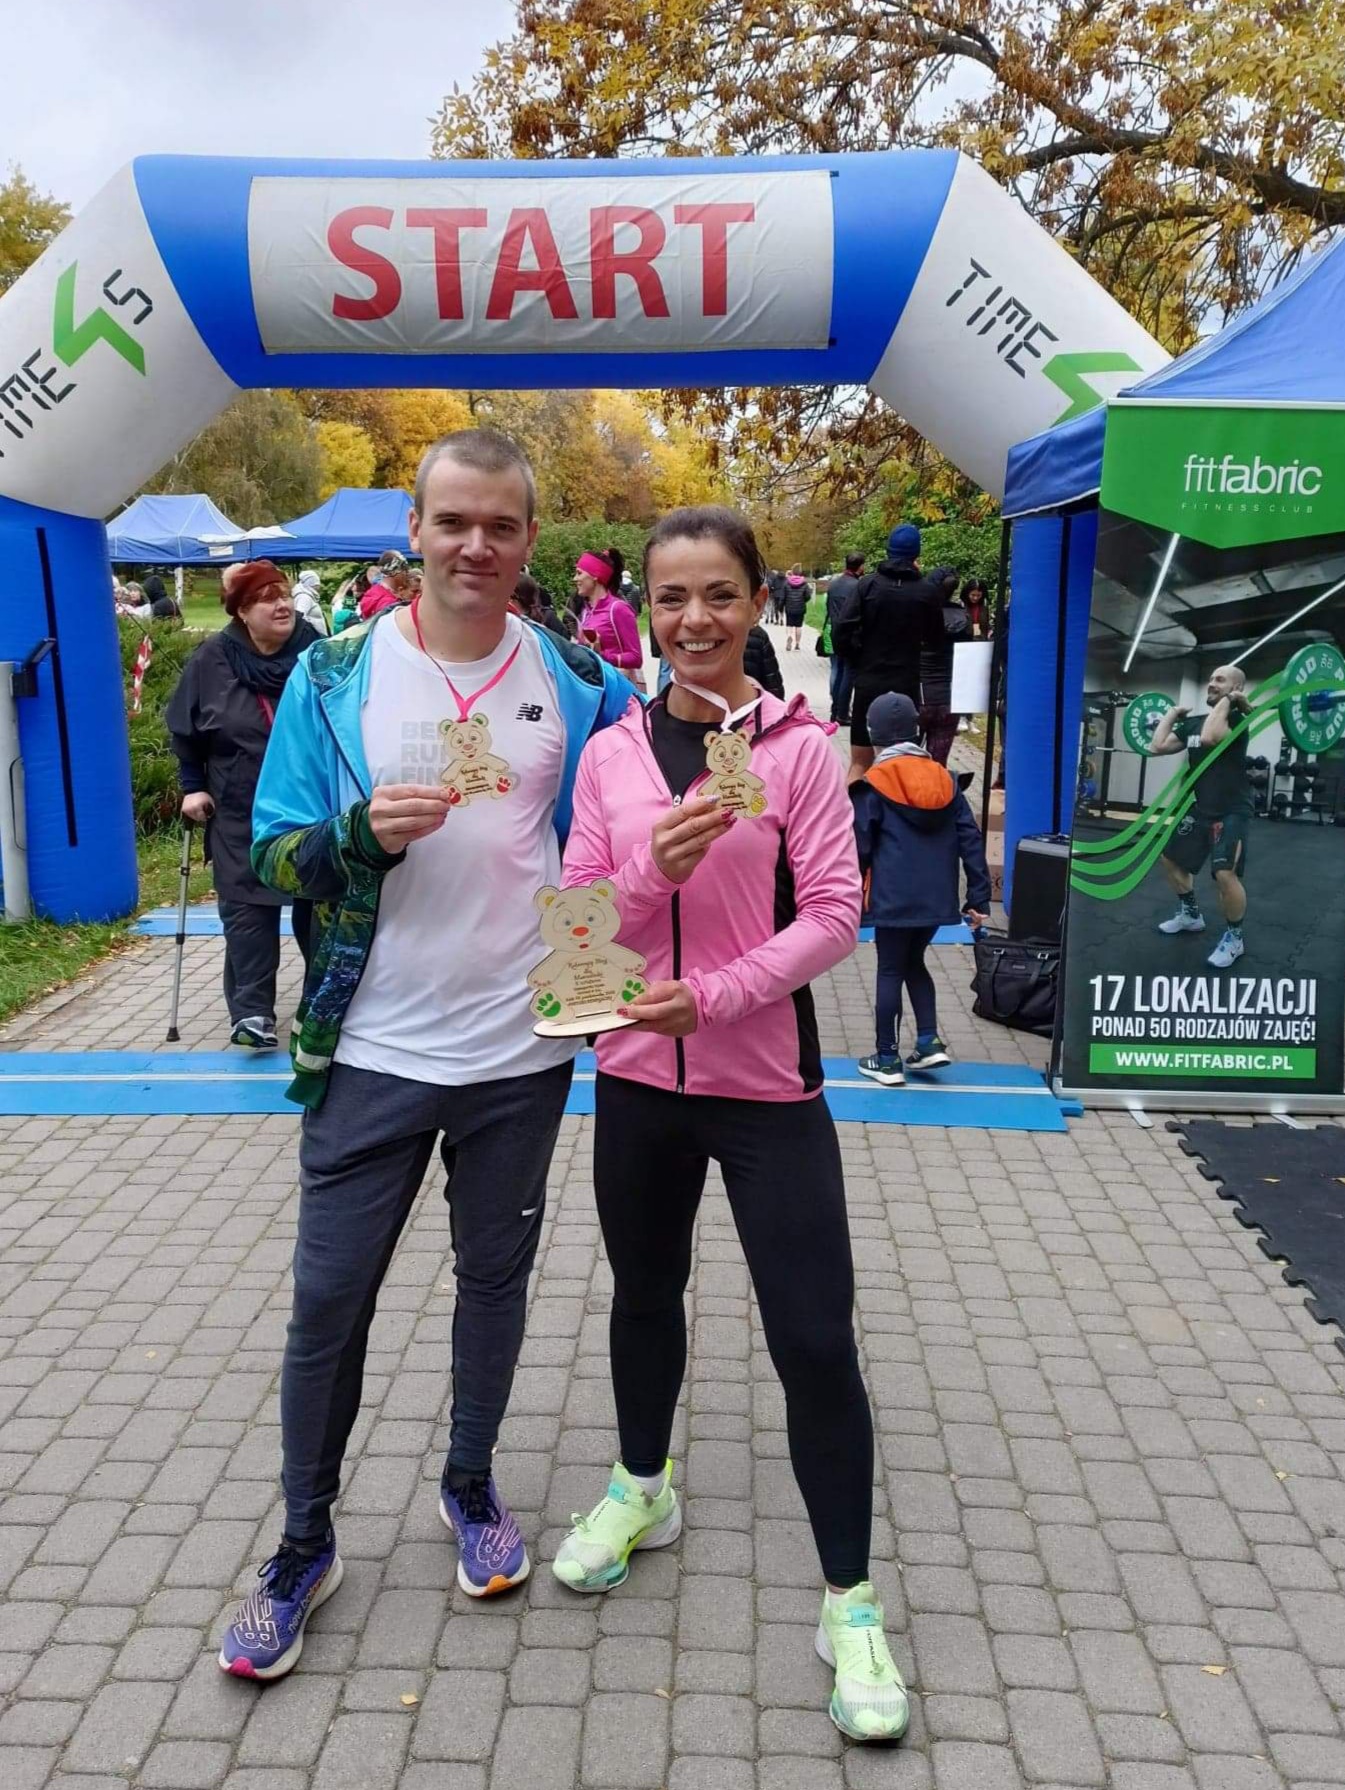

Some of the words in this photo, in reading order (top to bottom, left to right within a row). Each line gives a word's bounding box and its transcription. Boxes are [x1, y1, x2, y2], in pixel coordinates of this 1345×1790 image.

[327, 202, 755, 321] START
[1184, 454, 1323, 495] fitfabric
[1181, 503, 1261, 512] FITNESS
[1269, 504, 1313, 513] CLUB
[401, 721, 442, 740] BE
[1090, 975, 1126, 1012] 17
[1134, 975, 1317, 1015] LOKALIZACJI
[1092, 1016, 1146, 1037] PONAD
[1150, 1018, 1171, 1038] 50
[1175, 1015, 1260, 1041] RODZAJÓW
[1264, 1016, 1316, 1044] ZAJĘĆ!
[1115, 1052, 1293, 1070] WWW.FITFABRIC.PL
